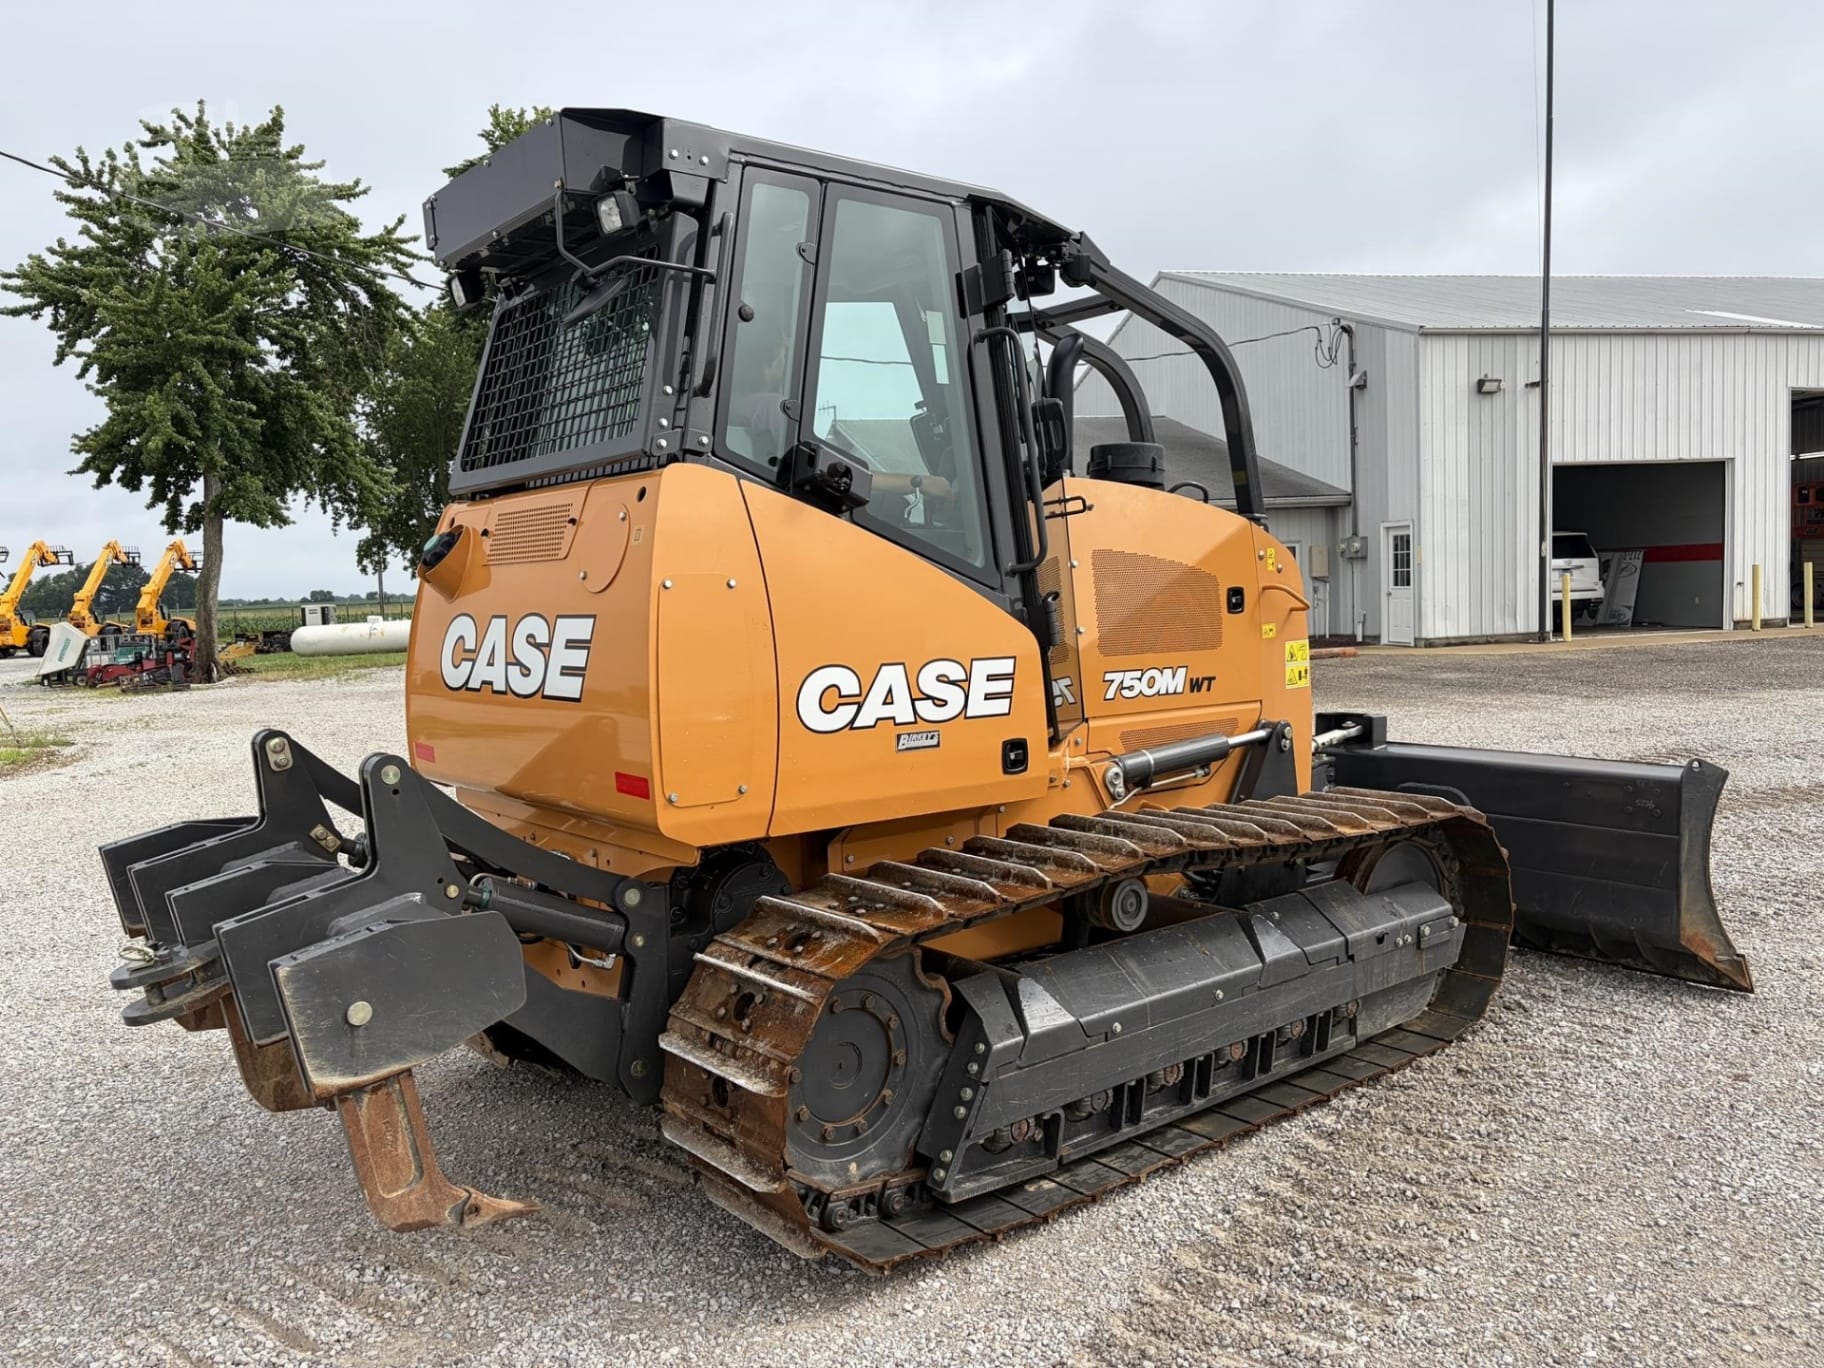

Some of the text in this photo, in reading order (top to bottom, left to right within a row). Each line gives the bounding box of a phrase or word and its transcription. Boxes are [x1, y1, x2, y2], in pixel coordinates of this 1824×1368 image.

[440, 612, 597, 703] CASE
[796, 655, 1016, 734] CASE
[1103, 665, 1216, 701] 750M WT
